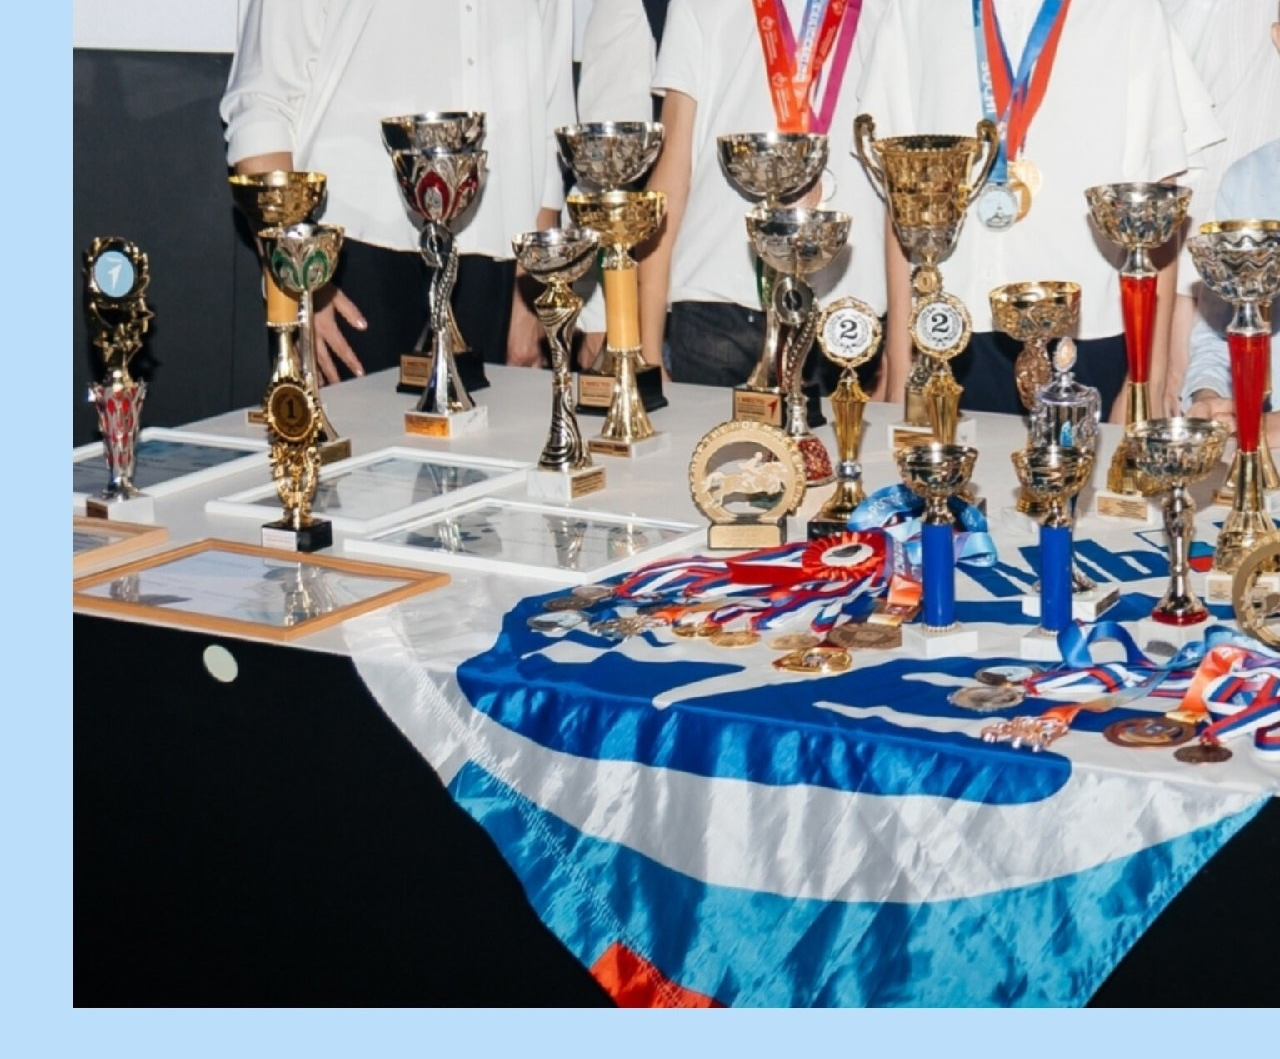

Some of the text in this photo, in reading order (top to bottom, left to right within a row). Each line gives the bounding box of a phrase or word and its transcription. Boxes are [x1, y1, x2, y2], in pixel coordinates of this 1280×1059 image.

[839, 319, 859, 340] 2
[930, 312, 950, 333] 2
[286, 397, 297, 419] 1
